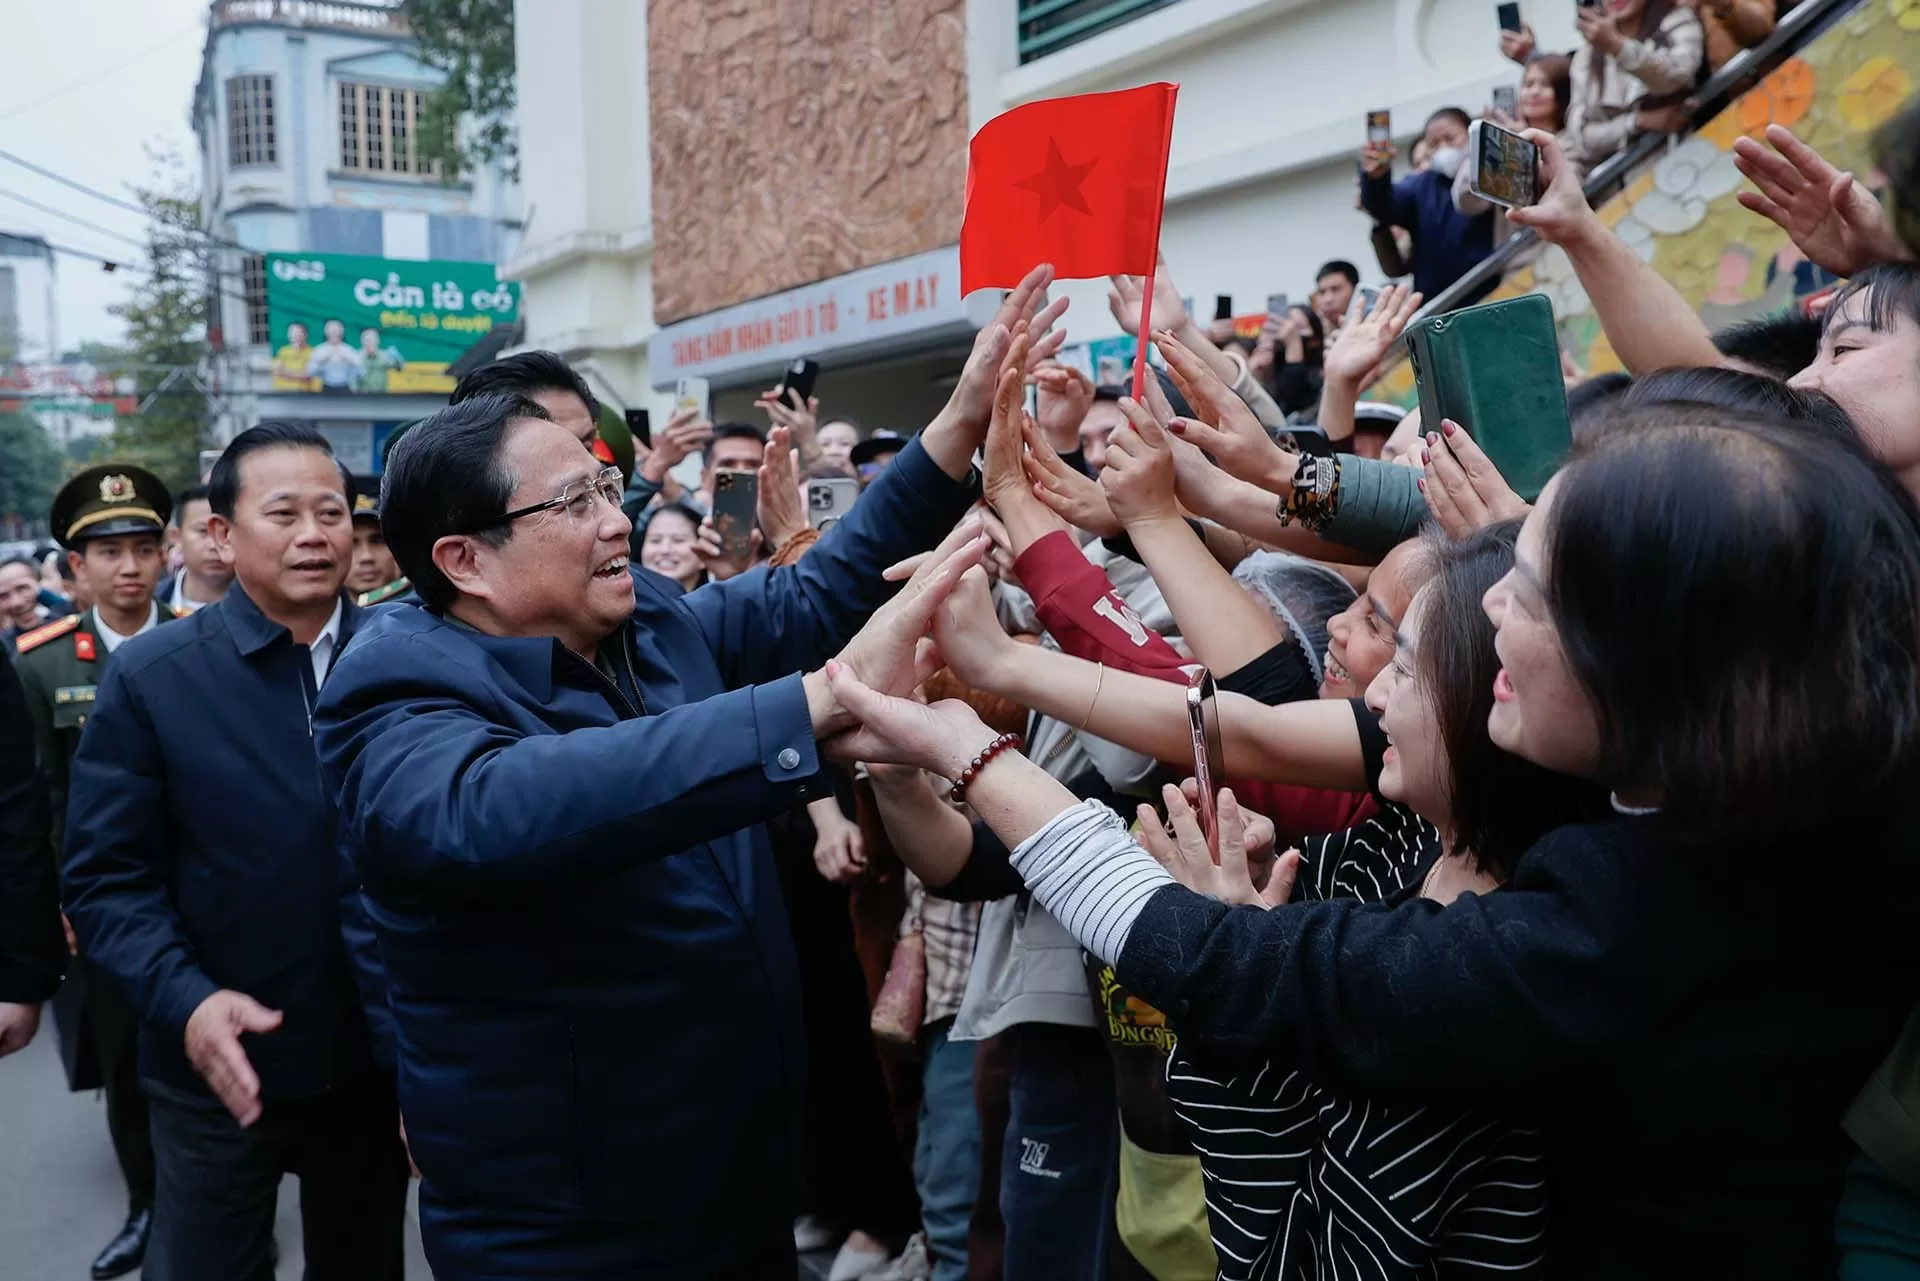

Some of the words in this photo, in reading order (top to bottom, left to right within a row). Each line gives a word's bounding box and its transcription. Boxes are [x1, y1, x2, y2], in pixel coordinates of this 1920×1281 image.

[431, 280, 464, 311] là
[471, 283, 513, 313] có
[867, 286, 888, 322] XE
